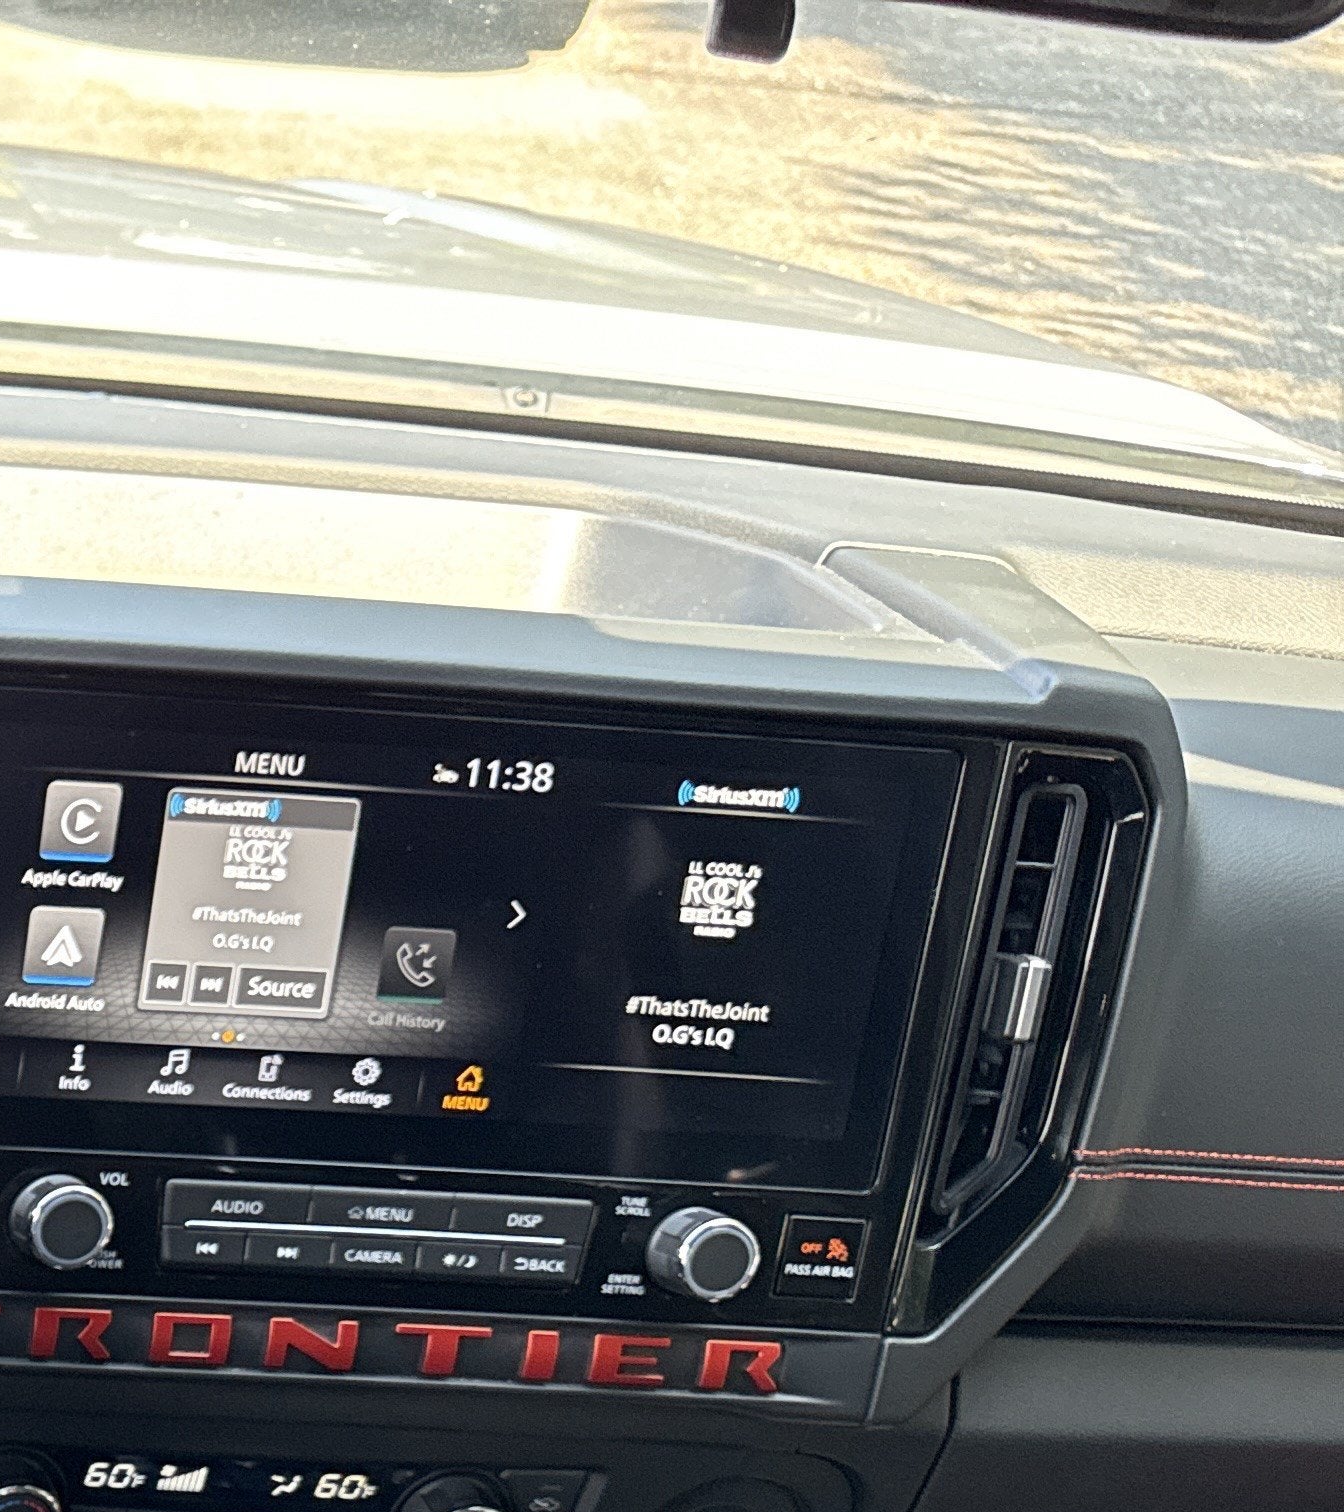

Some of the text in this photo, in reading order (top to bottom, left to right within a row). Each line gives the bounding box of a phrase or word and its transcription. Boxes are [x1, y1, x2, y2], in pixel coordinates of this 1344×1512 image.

[234, 751, 306, 777] MENU
[464, 757, 555, 793] 11:38
[224, 838, 290, 866] ROCK
[705, 861, 744, 878] COOL
[21, 868, 124, 893] Apple CarPlay
[680, 875, 759, 910] ROCK
[192, 905, 303, 927] #ThatsTheJoint
[247, 975, 317, 999] Source
[4, 992, 106, 1012] Android Auto
[625, 995, 772, 1023] #ThatsTheJoint
[395, 1013, 446, 1032] History
[58, 1075, 92, 1092] Info
[147, 1079, 195, 1096] Audio
[222, 1082, 312, 1102] Connections
[332, 1088, 393, 1109] Settings
[442, 1094, 490, 1112] MENU
[99, 1171, 130, 1187] VOL
[211, 1199, 264, 1215] AUDIO
[365, 1206, 413, 1223] MENU
[506, 1213, 545, 1229] DISP
[87, 1258, 124, 1269] OWER
[344, 1249, 404, 1266] CAMERA
[528, 1257, 565, 1273] BACK
[783, 1263, 812, 1276] PASS
[607, 1273, 642, 1285] ENTER
[600, 1283, 646, 1296] SETTING
